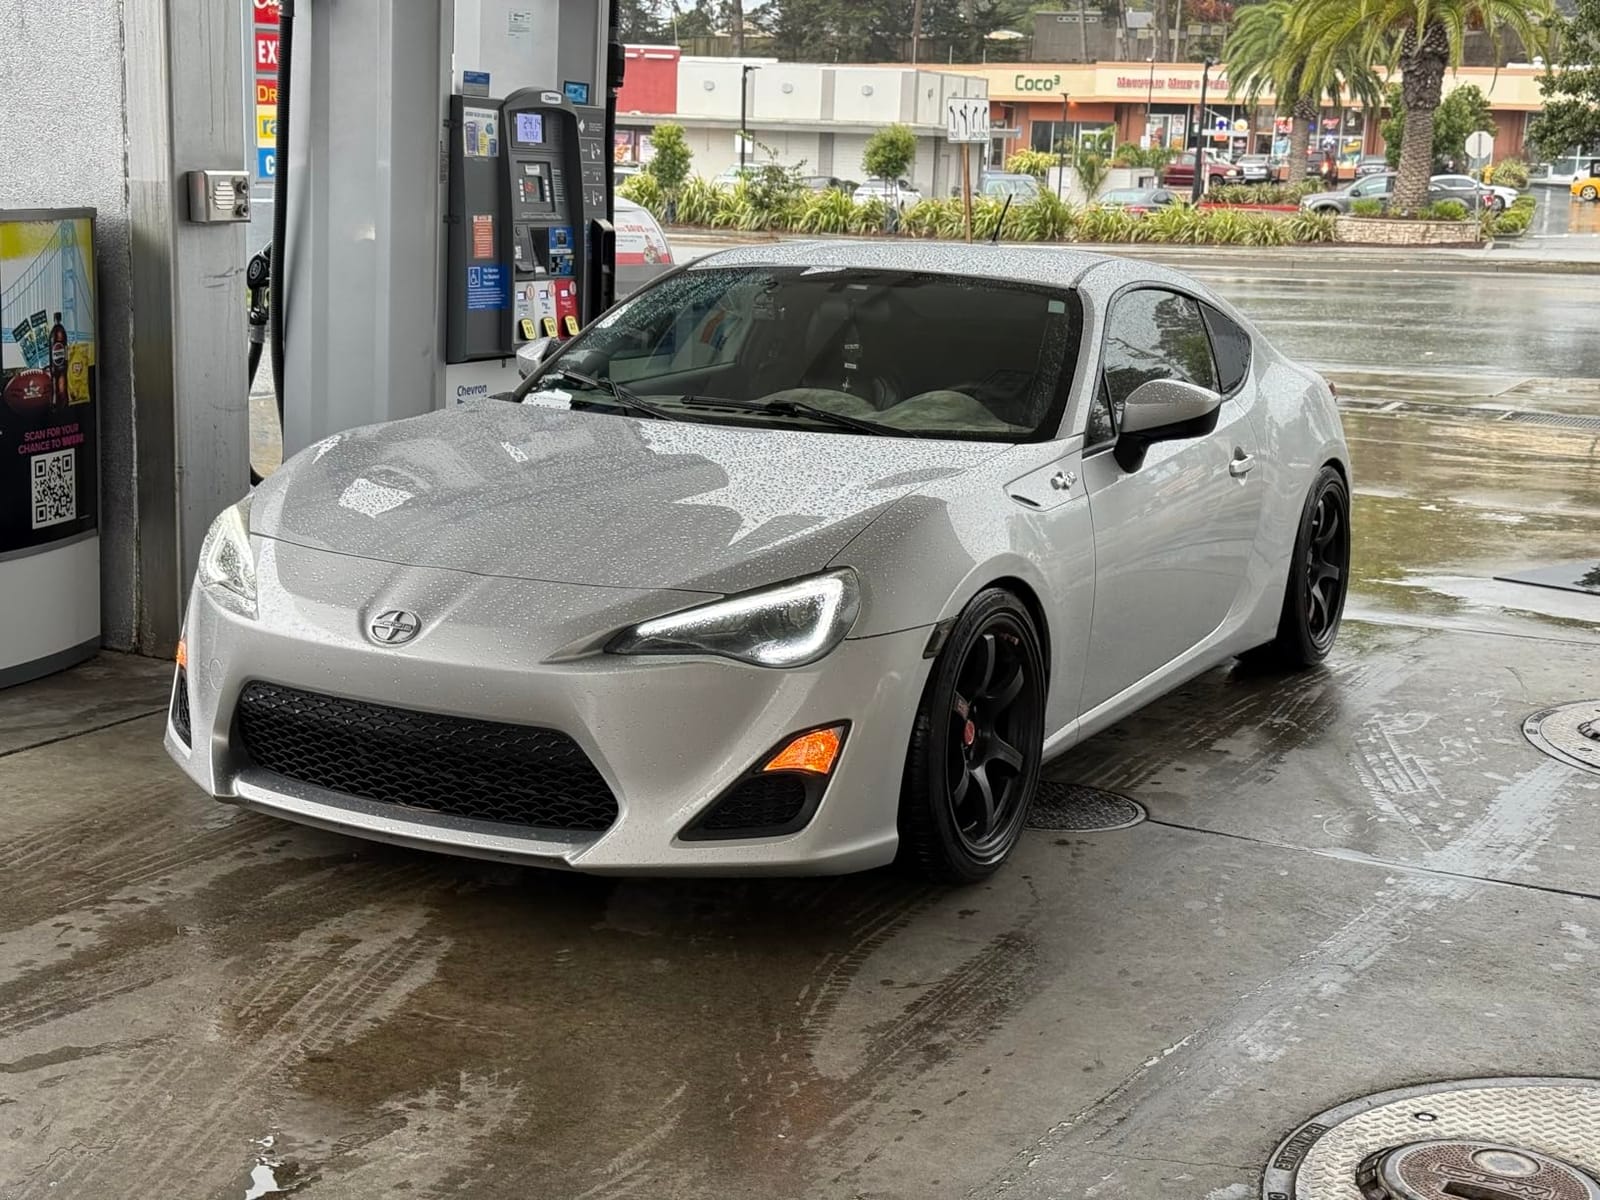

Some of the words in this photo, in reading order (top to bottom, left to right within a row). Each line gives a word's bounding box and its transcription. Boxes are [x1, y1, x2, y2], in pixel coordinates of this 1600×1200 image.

[258, 40, 279, 63] EX
[457, 384, 487, 397] Chevron
[24, 430, 46, 441] SCAN
[46, 427, 61, 438] FOR
[18, 440, 50, 455] CHANCE
[52, 438, 61, 448] TO
